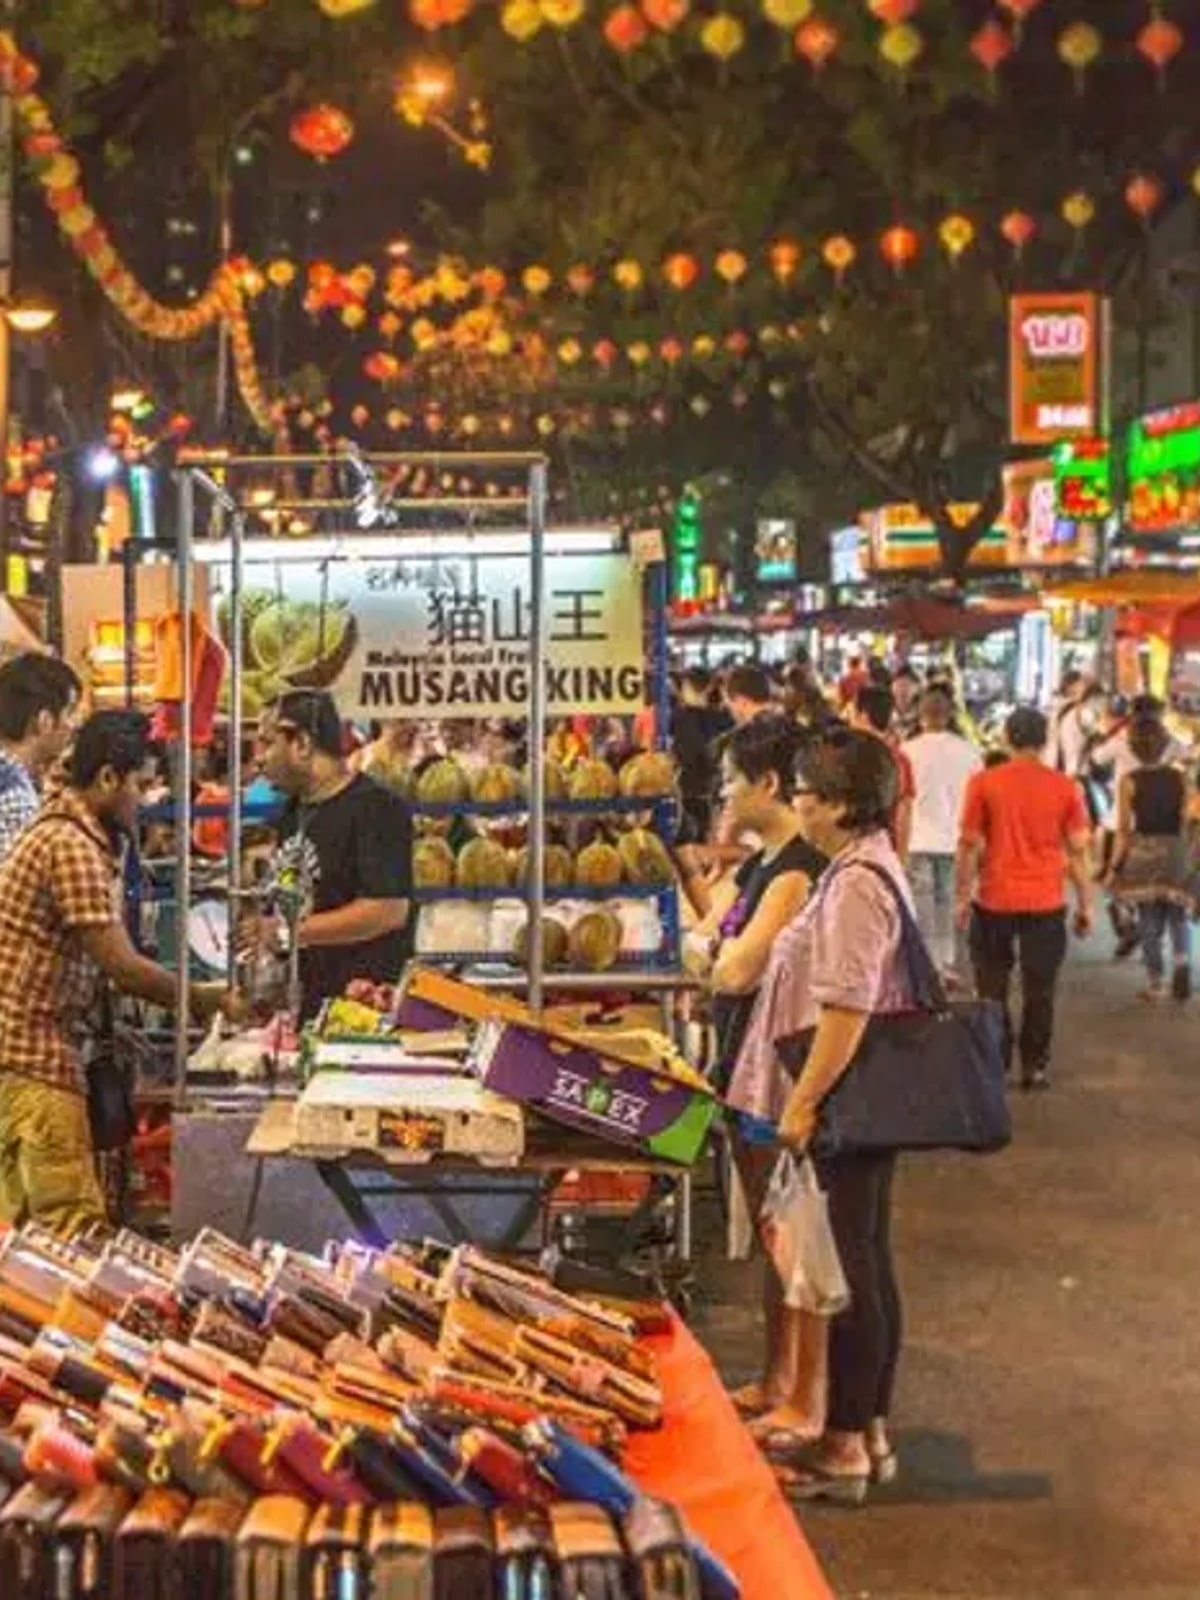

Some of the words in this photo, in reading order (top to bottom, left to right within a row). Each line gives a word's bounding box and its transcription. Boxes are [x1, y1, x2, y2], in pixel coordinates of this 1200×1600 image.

[427, 587, 608, 646] 猫山王
[359, 667, 529, 707] MUSANG
[546, 665, 643, 703] KING
